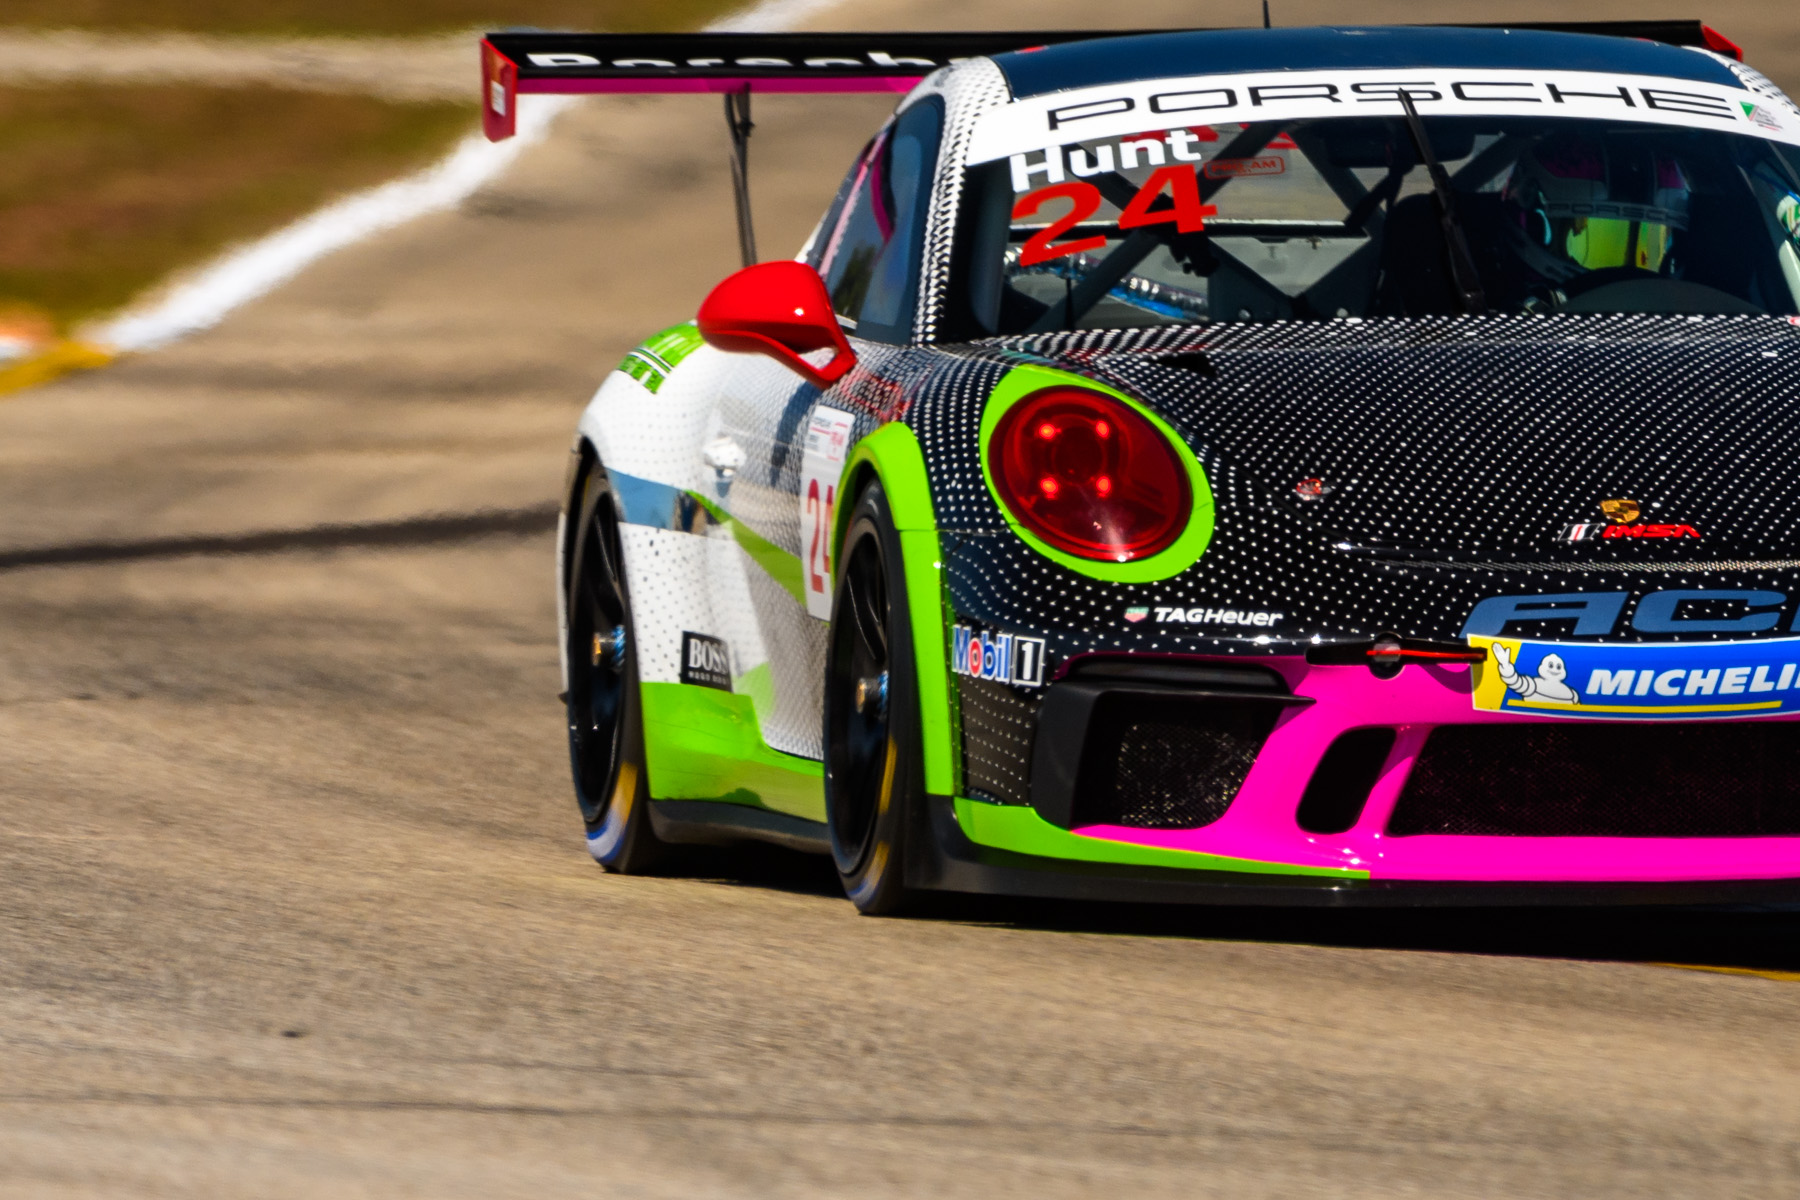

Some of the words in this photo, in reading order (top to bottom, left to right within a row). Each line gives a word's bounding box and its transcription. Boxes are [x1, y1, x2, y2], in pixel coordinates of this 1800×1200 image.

[1045, 82, 1737, 131] PORSCHE
[1009, 130, 1202, 193] Hunt
[1011, 164, 1218, 267] 24
[1602, 524, 1701, 538] IMSA
[688, 638, 728, 676] BOSS
[952, 624, 1013, 685] Mobil
